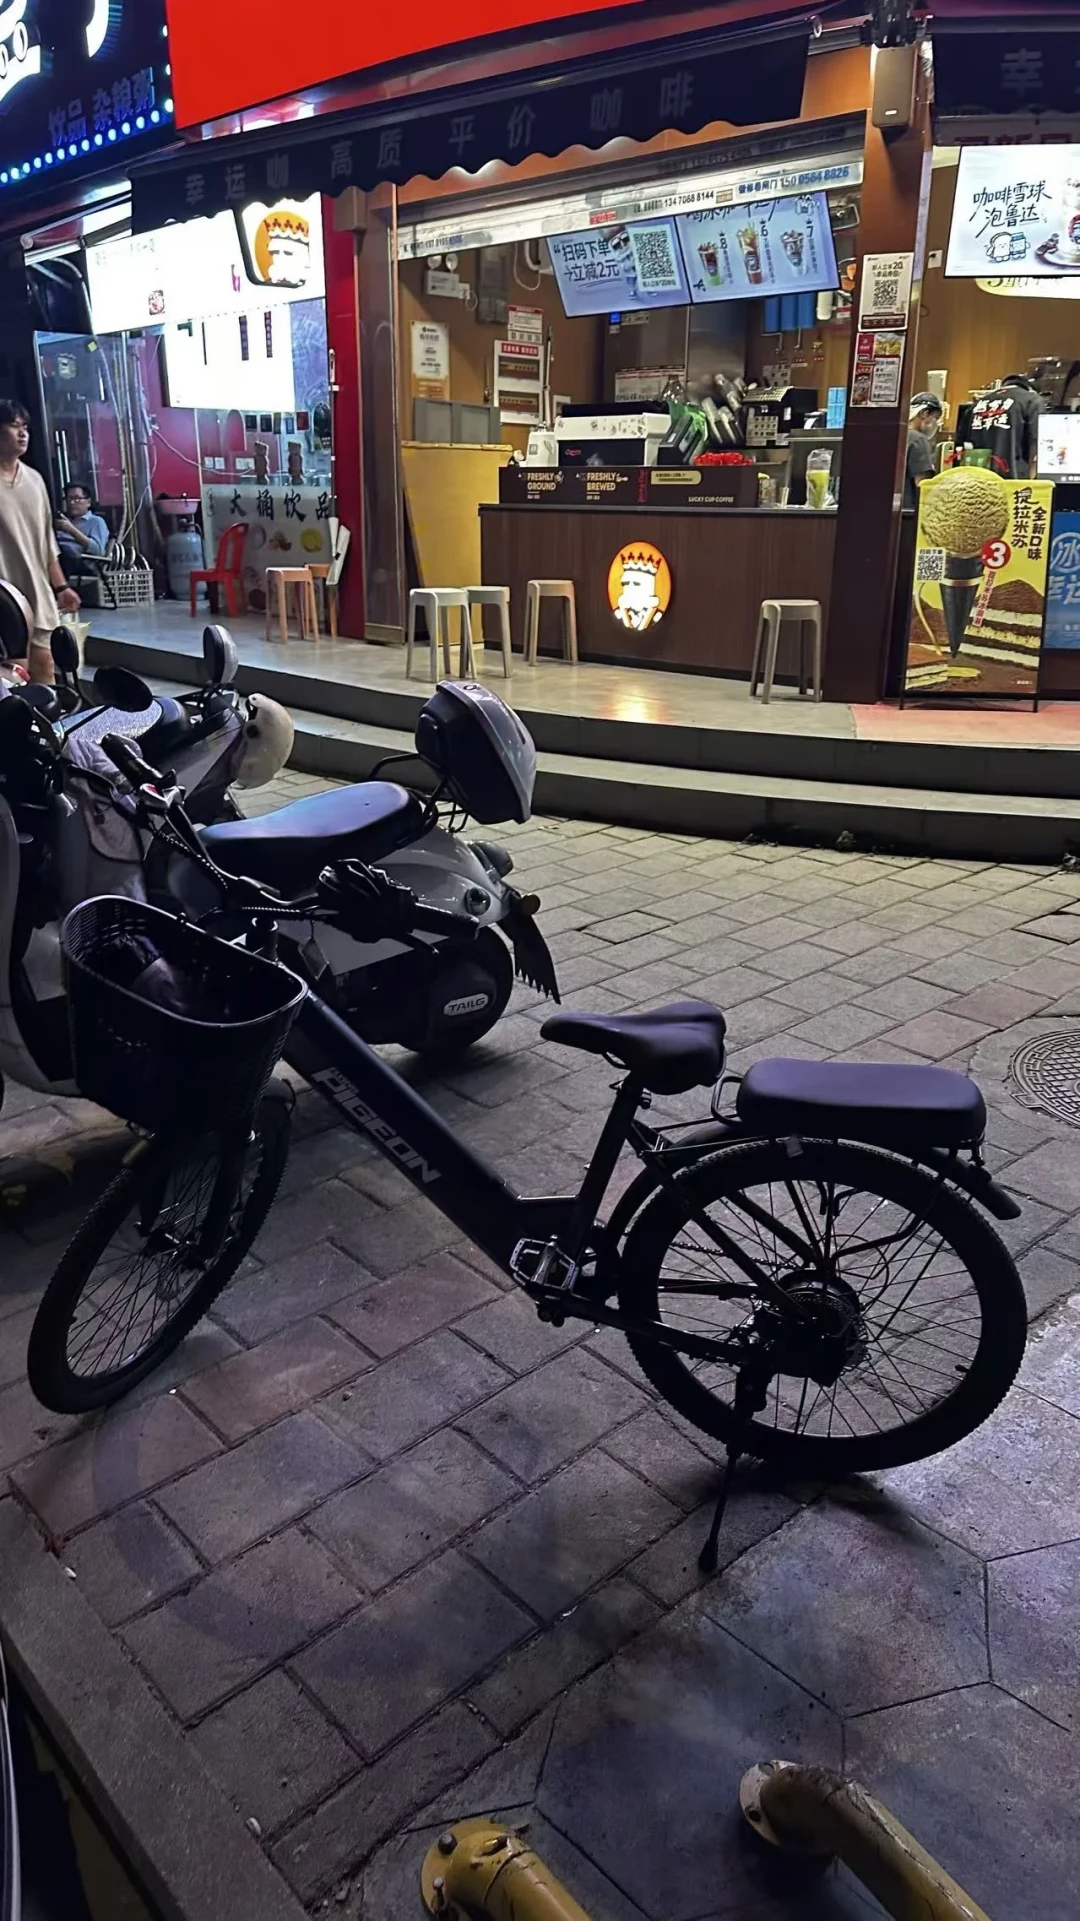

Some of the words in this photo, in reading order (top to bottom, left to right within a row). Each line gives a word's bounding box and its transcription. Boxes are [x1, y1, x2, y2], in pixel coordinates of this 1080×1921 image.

[969, 180, 1053, 222] 咖啡雪球
[975, 203, 1040, 239] 泡鲁达
[571, 258, 619, 282] 立减2元
[527, 472, 555, 481] FRESHLY
[527, 482, 556, 491] GROUND
[586, 472, 616, 481] FRESHLY
[586, 482, 616, 491] BREWED
[230, 488, 333, 522] 大桶饮品
[1011, 486, 1040, 549] 提拉米苏
[1027, 506, 1048, 561] 全新口味
[447, 995, 488, 1015] TAILG
[311, 1068, 442, 1183] PIGEON
